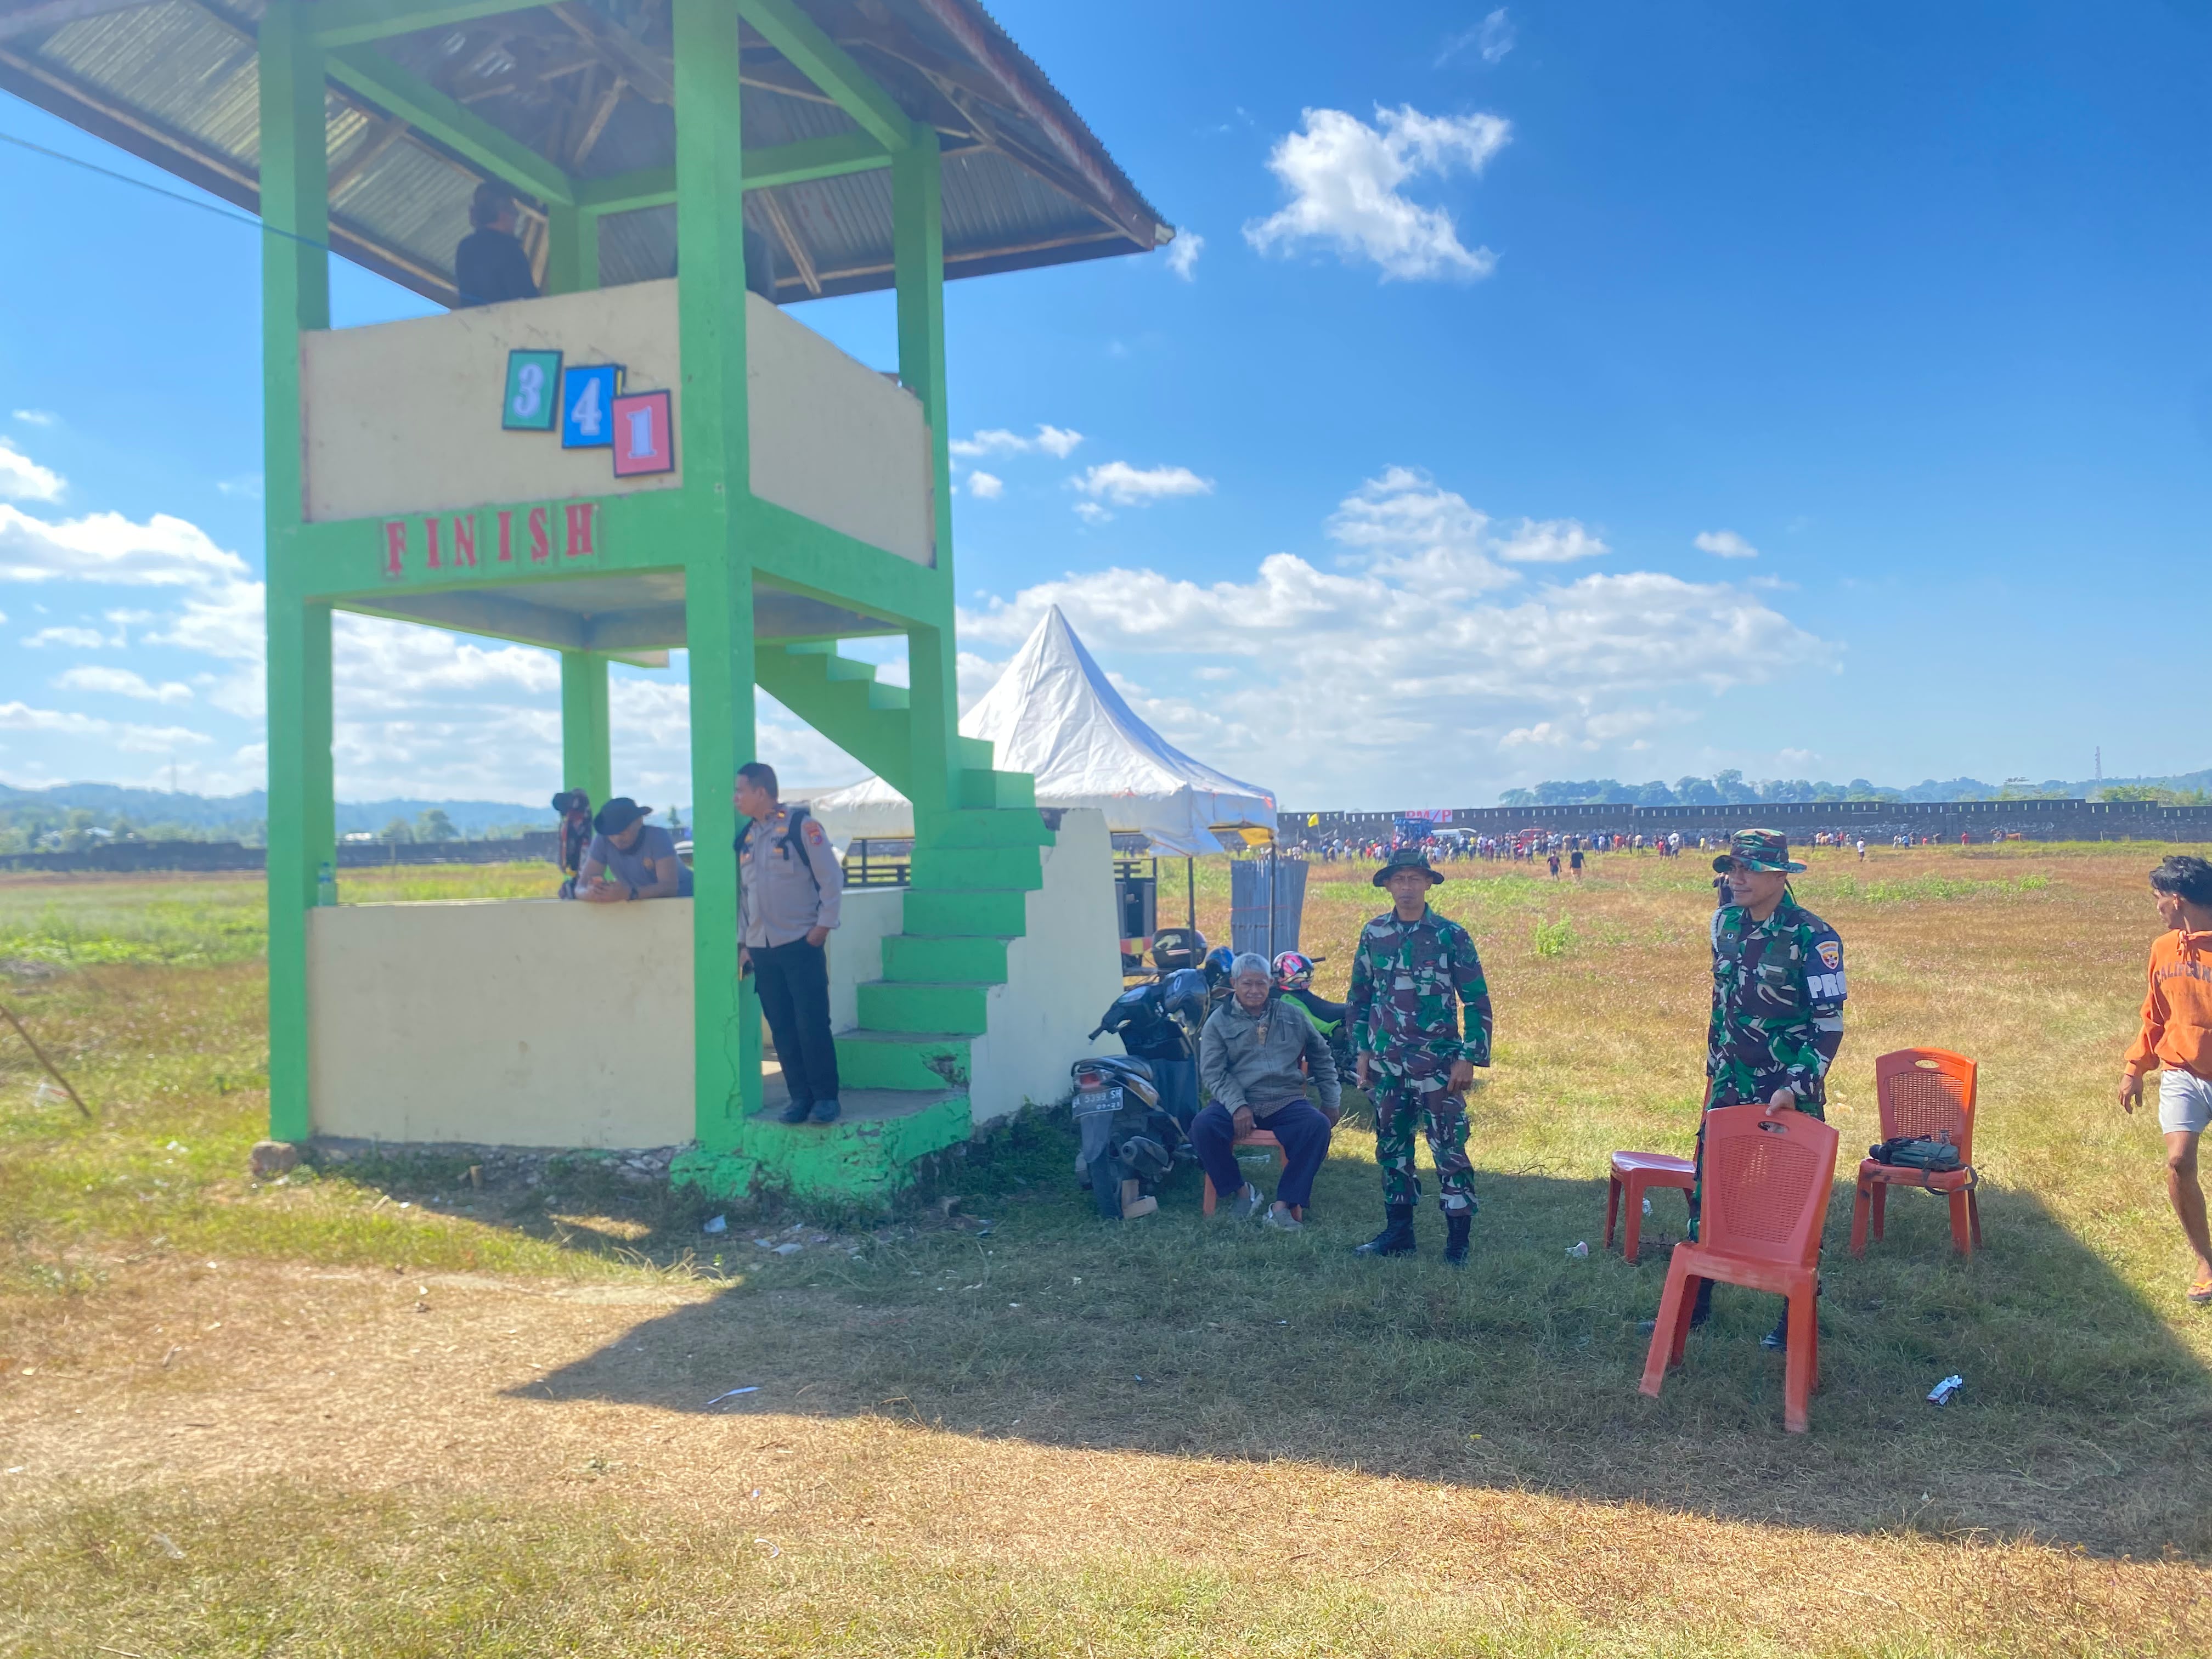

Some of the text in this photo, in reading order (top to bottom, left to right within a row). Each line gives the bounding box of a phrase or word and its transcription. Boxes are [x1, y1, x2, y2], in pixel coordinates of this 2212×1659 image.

[514, 363, 656, 458] 3 4 1
[386, 503, 594, 574] FINISH
